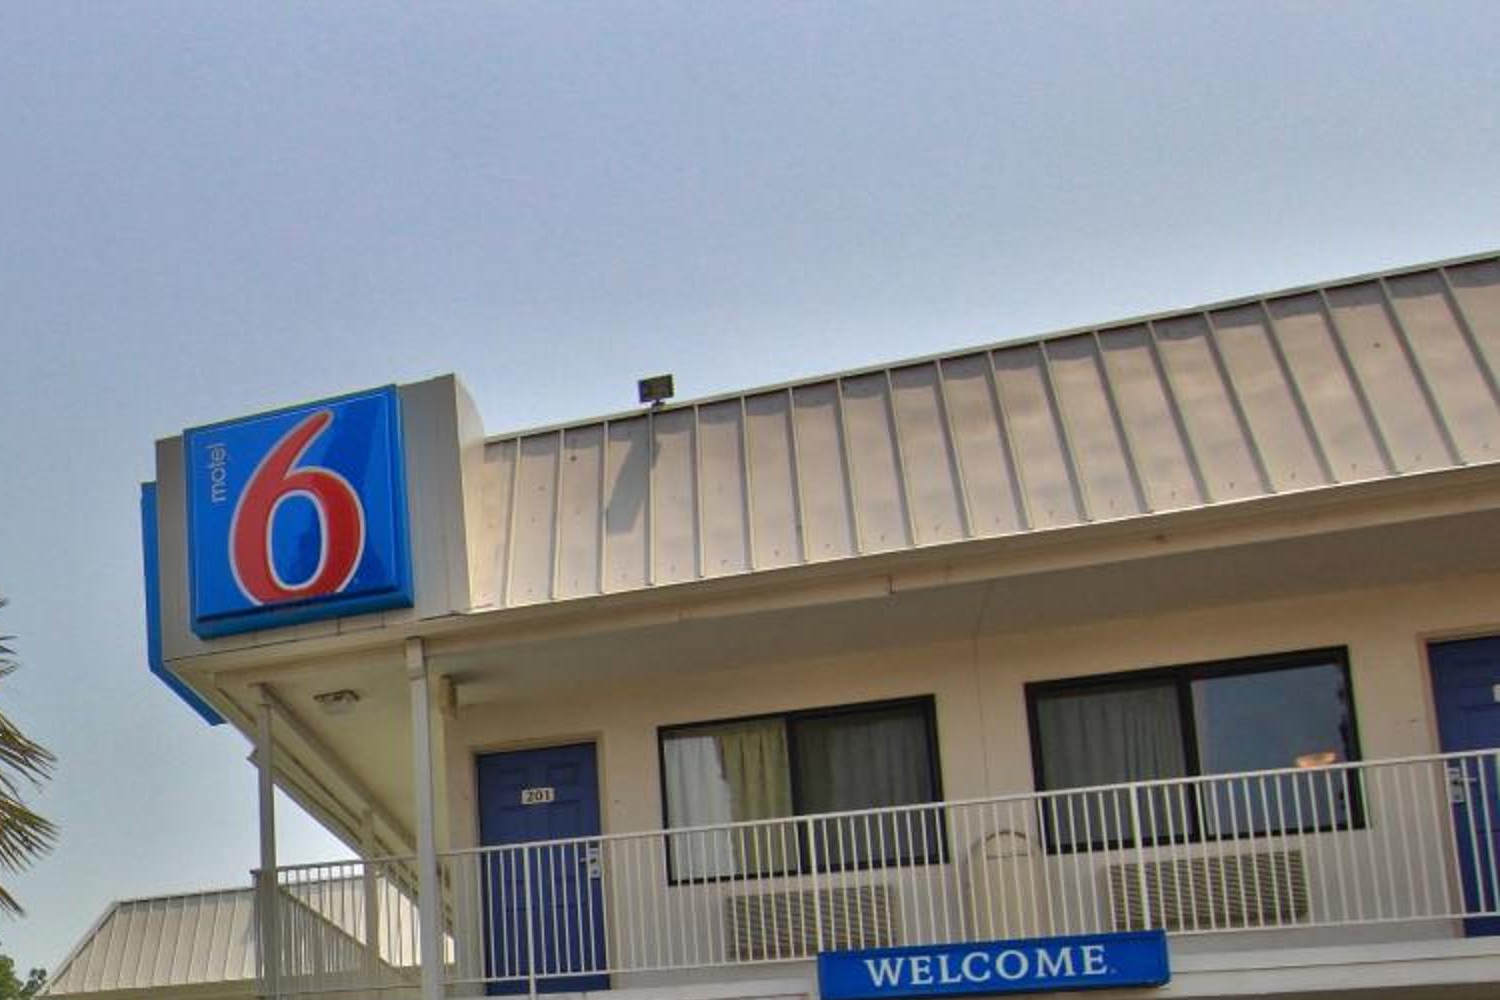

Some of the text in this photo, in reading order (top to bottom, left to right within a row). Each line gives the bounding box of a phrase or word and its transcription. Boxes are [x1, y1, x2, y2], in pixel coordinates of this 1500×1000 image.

[206, 442, 227, 503] motel
[228, 409, 366, 606] 6
[864, 944, 1108, 988] WELCOME
